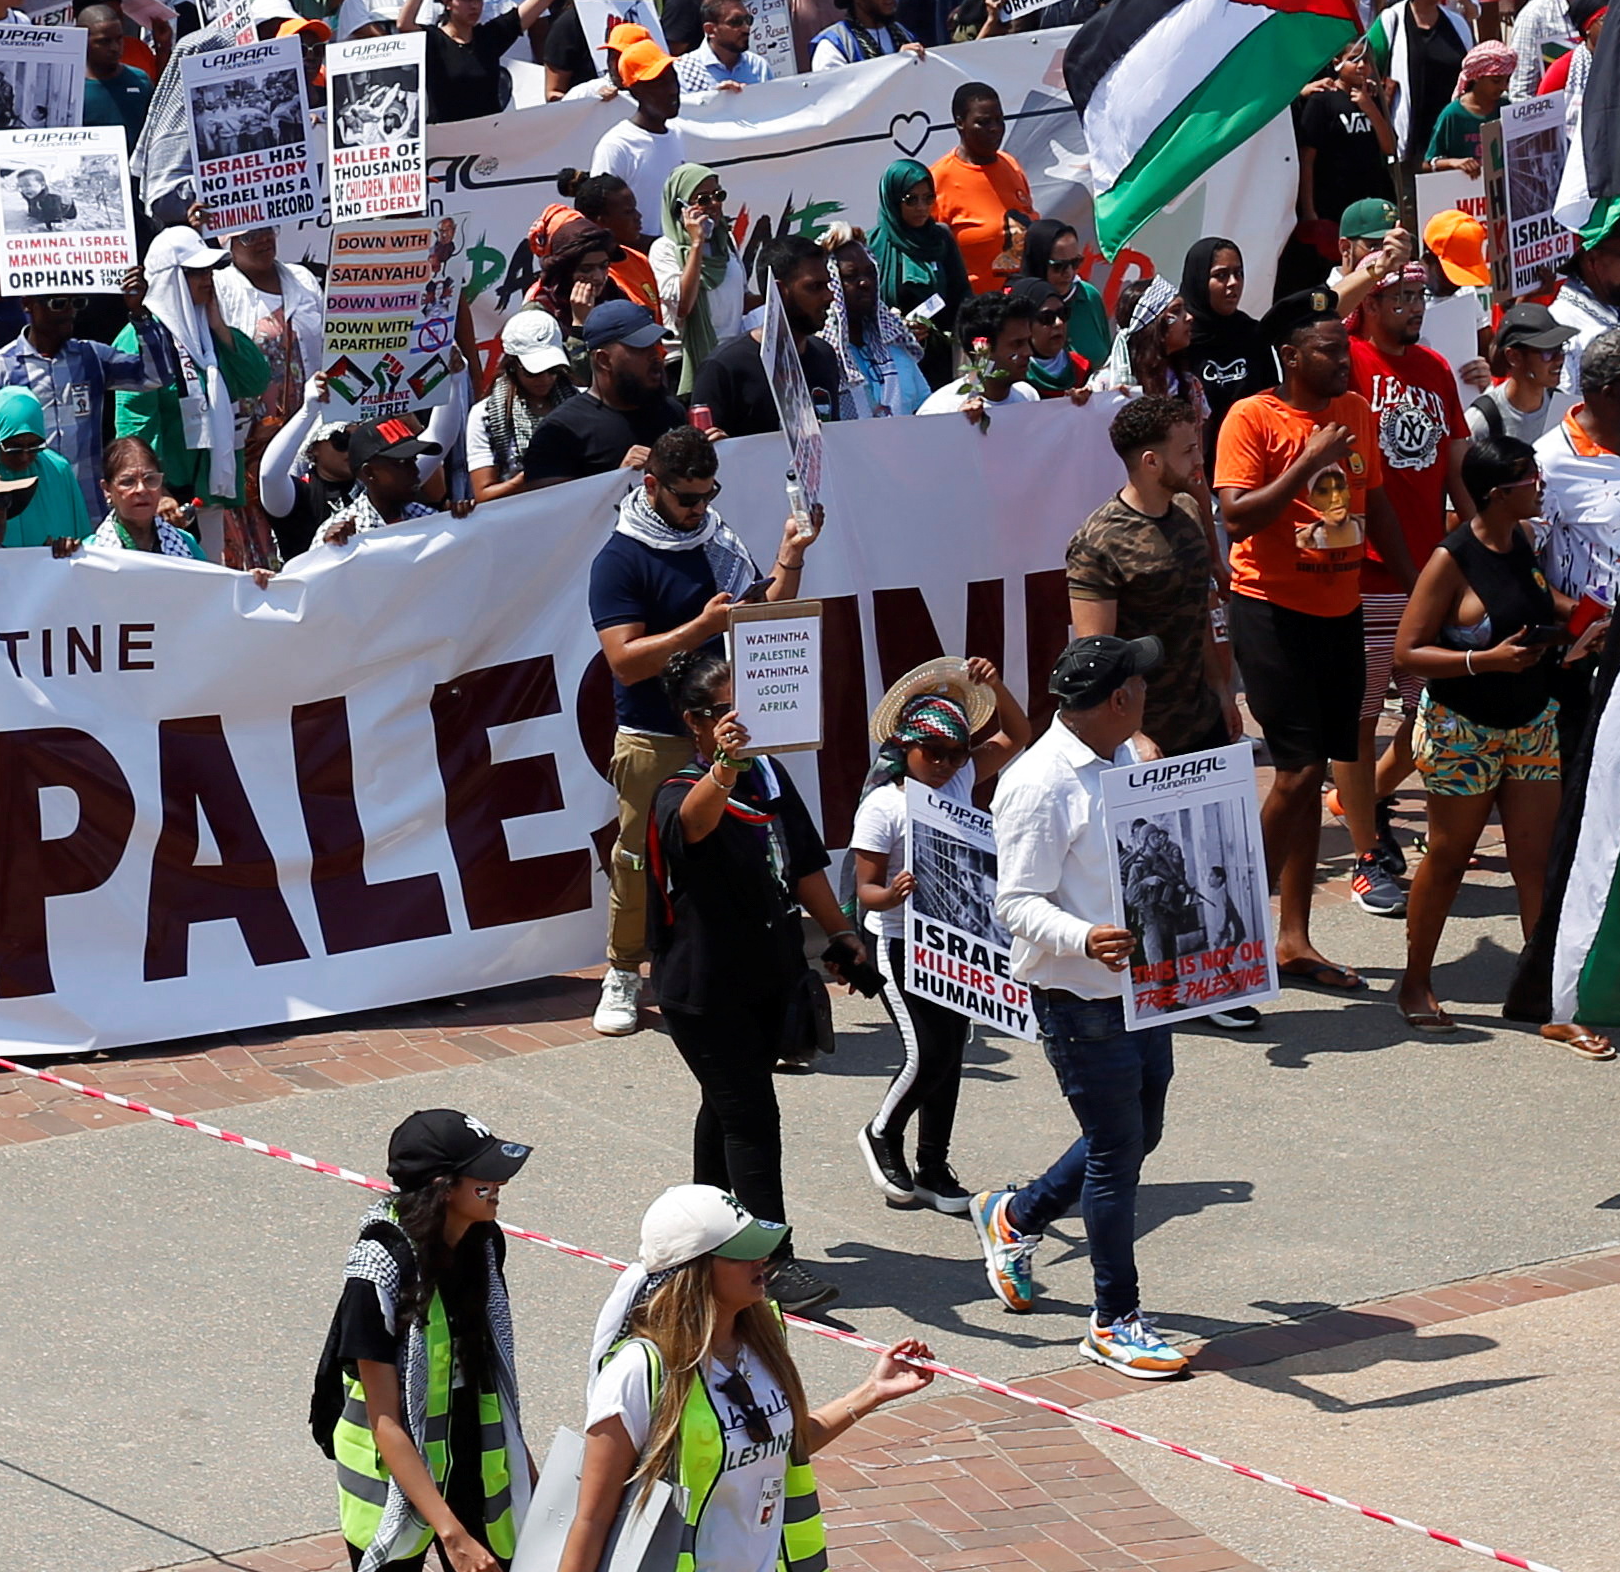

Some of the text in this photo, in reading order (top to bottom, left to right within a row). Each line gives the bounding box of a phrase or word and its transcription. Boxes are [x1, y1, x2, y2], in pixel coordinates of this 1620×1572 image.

[202, 46, 281, 69] LAJPAAL
[342, 40, 408, 60] LAJPAAL
[1513, 99, 1554, 120] LAJPAAL
[12, 132, 100, 145] LAJPAAL
[200, 144, 307, 178] ISRAEL HAS
[333, 142, 421, 167] KILLER OF
[201, 159, 308, 194] NO HISTORY
[334, 157, 422, 181] THOUSANDS
[204, 177, 312, 209] ISRAEL HAS A
[334, 173, 422, 202] OF WOMEN
[267, 193, 315, 220] RECORD
[336, 194, 422, 219] AND ELDERLY
[6, 235, 129, 250] CRIMINAL ISRAEL
[338, 233, 429, 251] DOWN WITH
[1514, 234, 1570, 269] KILLERS OF
[8, 250, 129, 268] MAKING CHILDREN
[9, 269, 95, 289] ORPHANS
[331, 264, 428, 283] SATANYAHU
[327, 294, 417, 310] DOWN WITH
[324, 319, 415, 334] DOWN WITH
[328, 336, 408, 351] APARTHEID
[378, 401, 410, 418] FREE
[745, 631, 810, 646] WATHINTHA
[749, 647, 806, 663] iPALESTINE
[746, 665, 810, 680] WATHINTHA
[757, 683, 799, 696] uSOUTH
[758, 700, 798, 713] AFRIKA
[1128, 755, 1228, 789] LAJPAAL
[1151, 774, 1207, 793] FOUNDATION
[1132, 939, 1265, 986] THIS IS NOT OK
[913, 945, 1029, 1008] KILLERS OF
[1134, 963, 1269, 1014] FREE PALESTINE
[913, 968, 1030, 1033] HUMANITY
